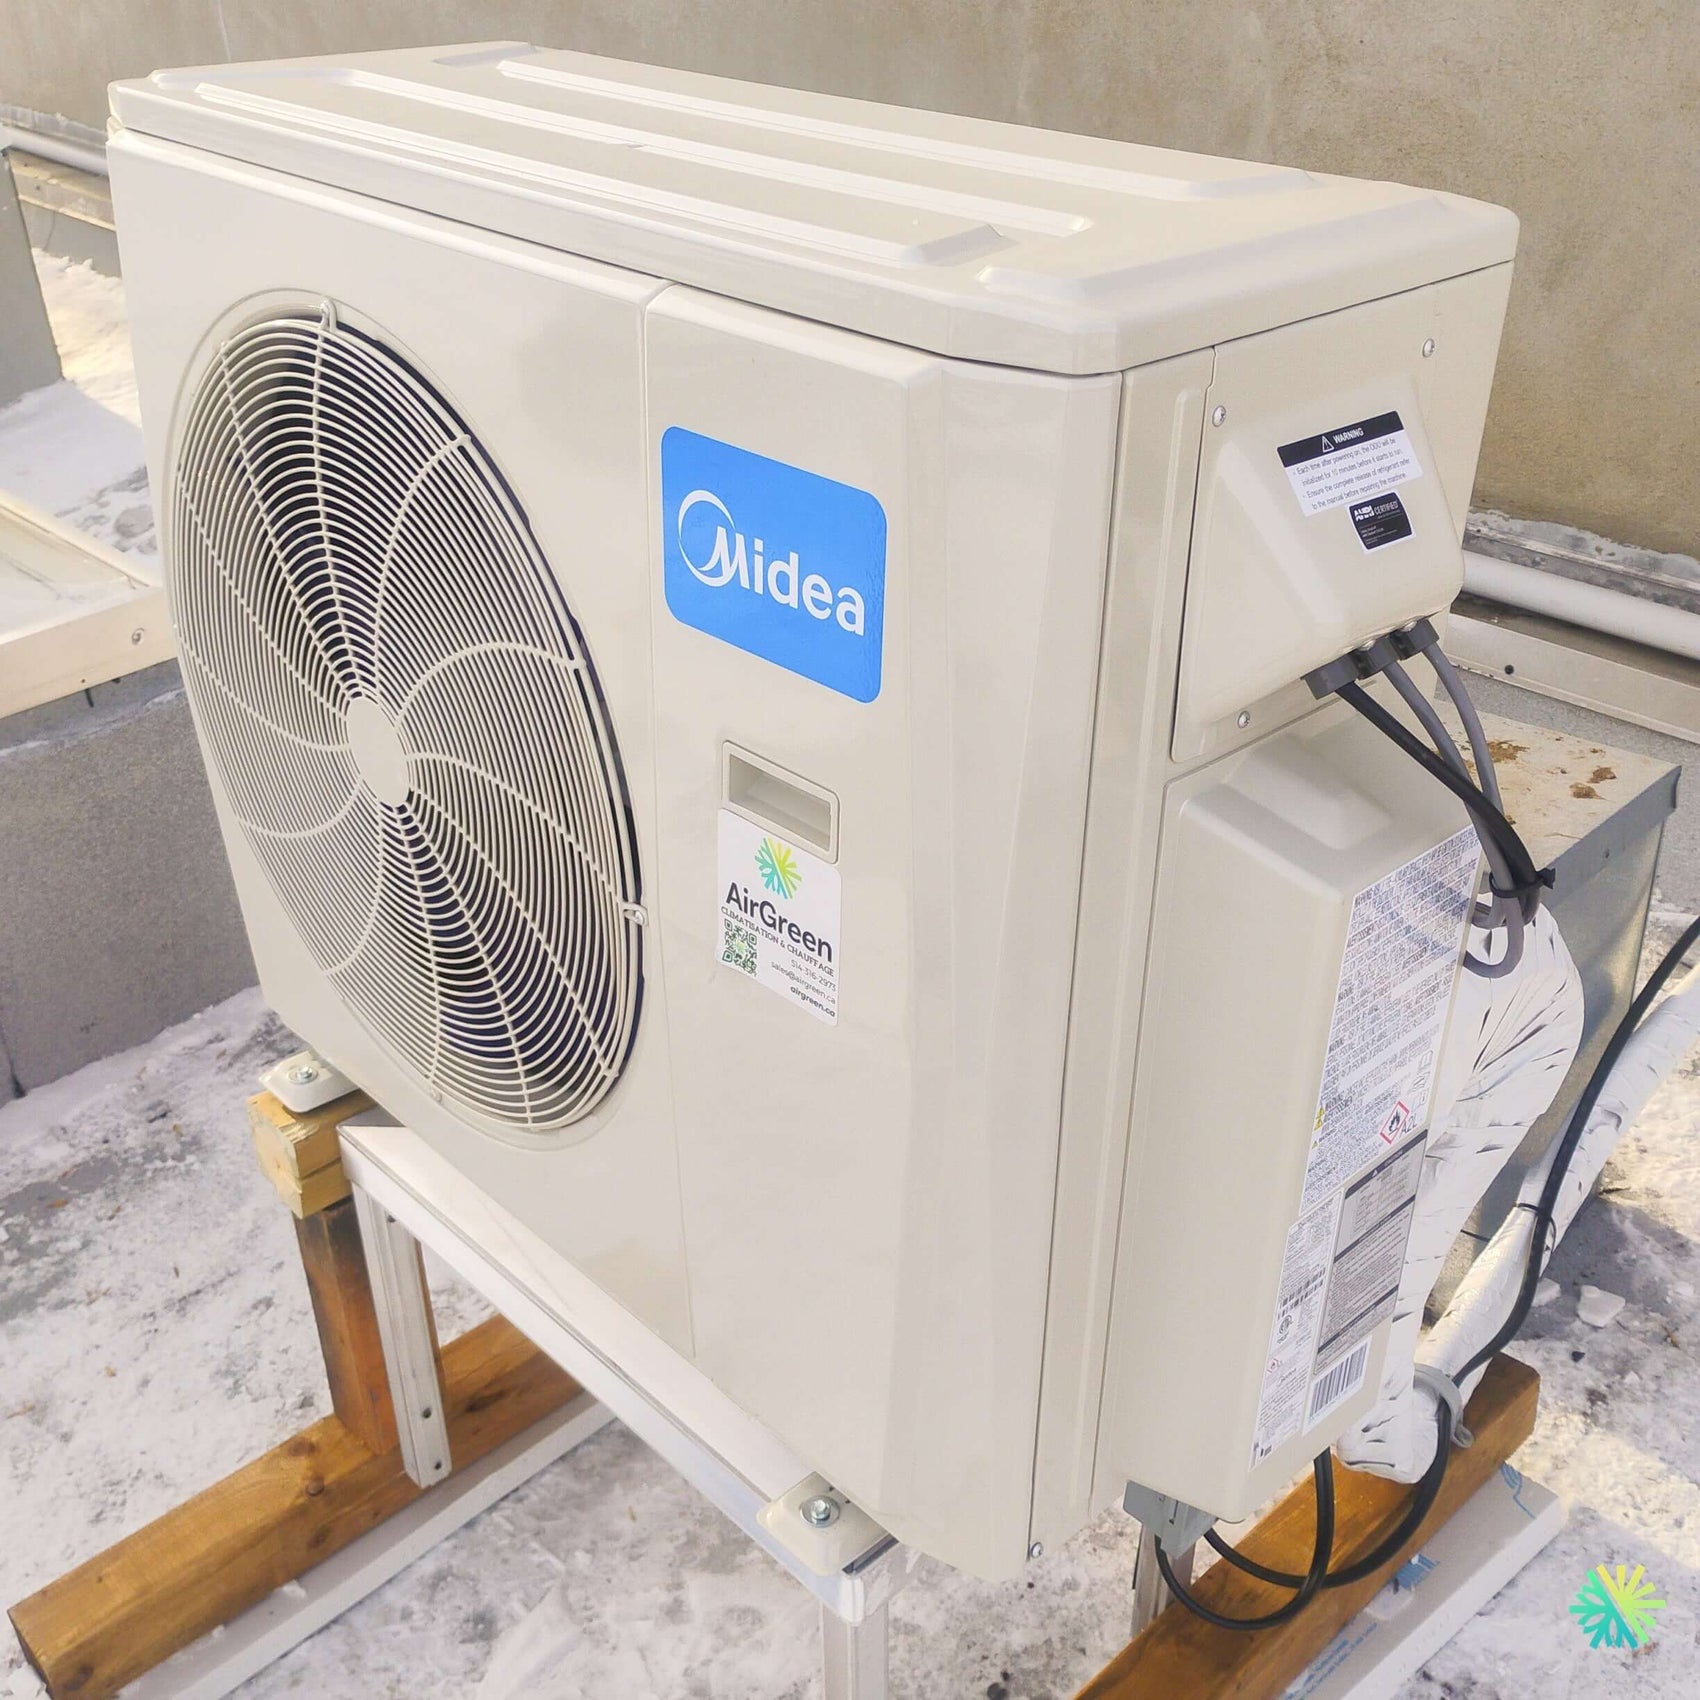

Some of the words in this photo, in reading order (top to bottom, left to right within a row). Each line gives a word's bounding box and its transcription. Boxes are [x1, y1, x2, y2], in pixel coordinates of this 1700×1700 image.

[1333, 427, 1364, 444] WARNING
[1373, 500, 1399, 516] CERTIFIED
[678, 489, 865, 637] Midea
[725, 881, 833, 963] AirGreen
[720, 905, 780, 945] CLIMATISATION
[779, 938, 787, 949] &
[786, 943, 835, 978] CHAUFFAGE
[770, 960, 837, 1005] sales@airgreen.ca
[790, 985, 836, 1017] airgreen.ca
[1400, 1112, 1418, 1135] A2L
